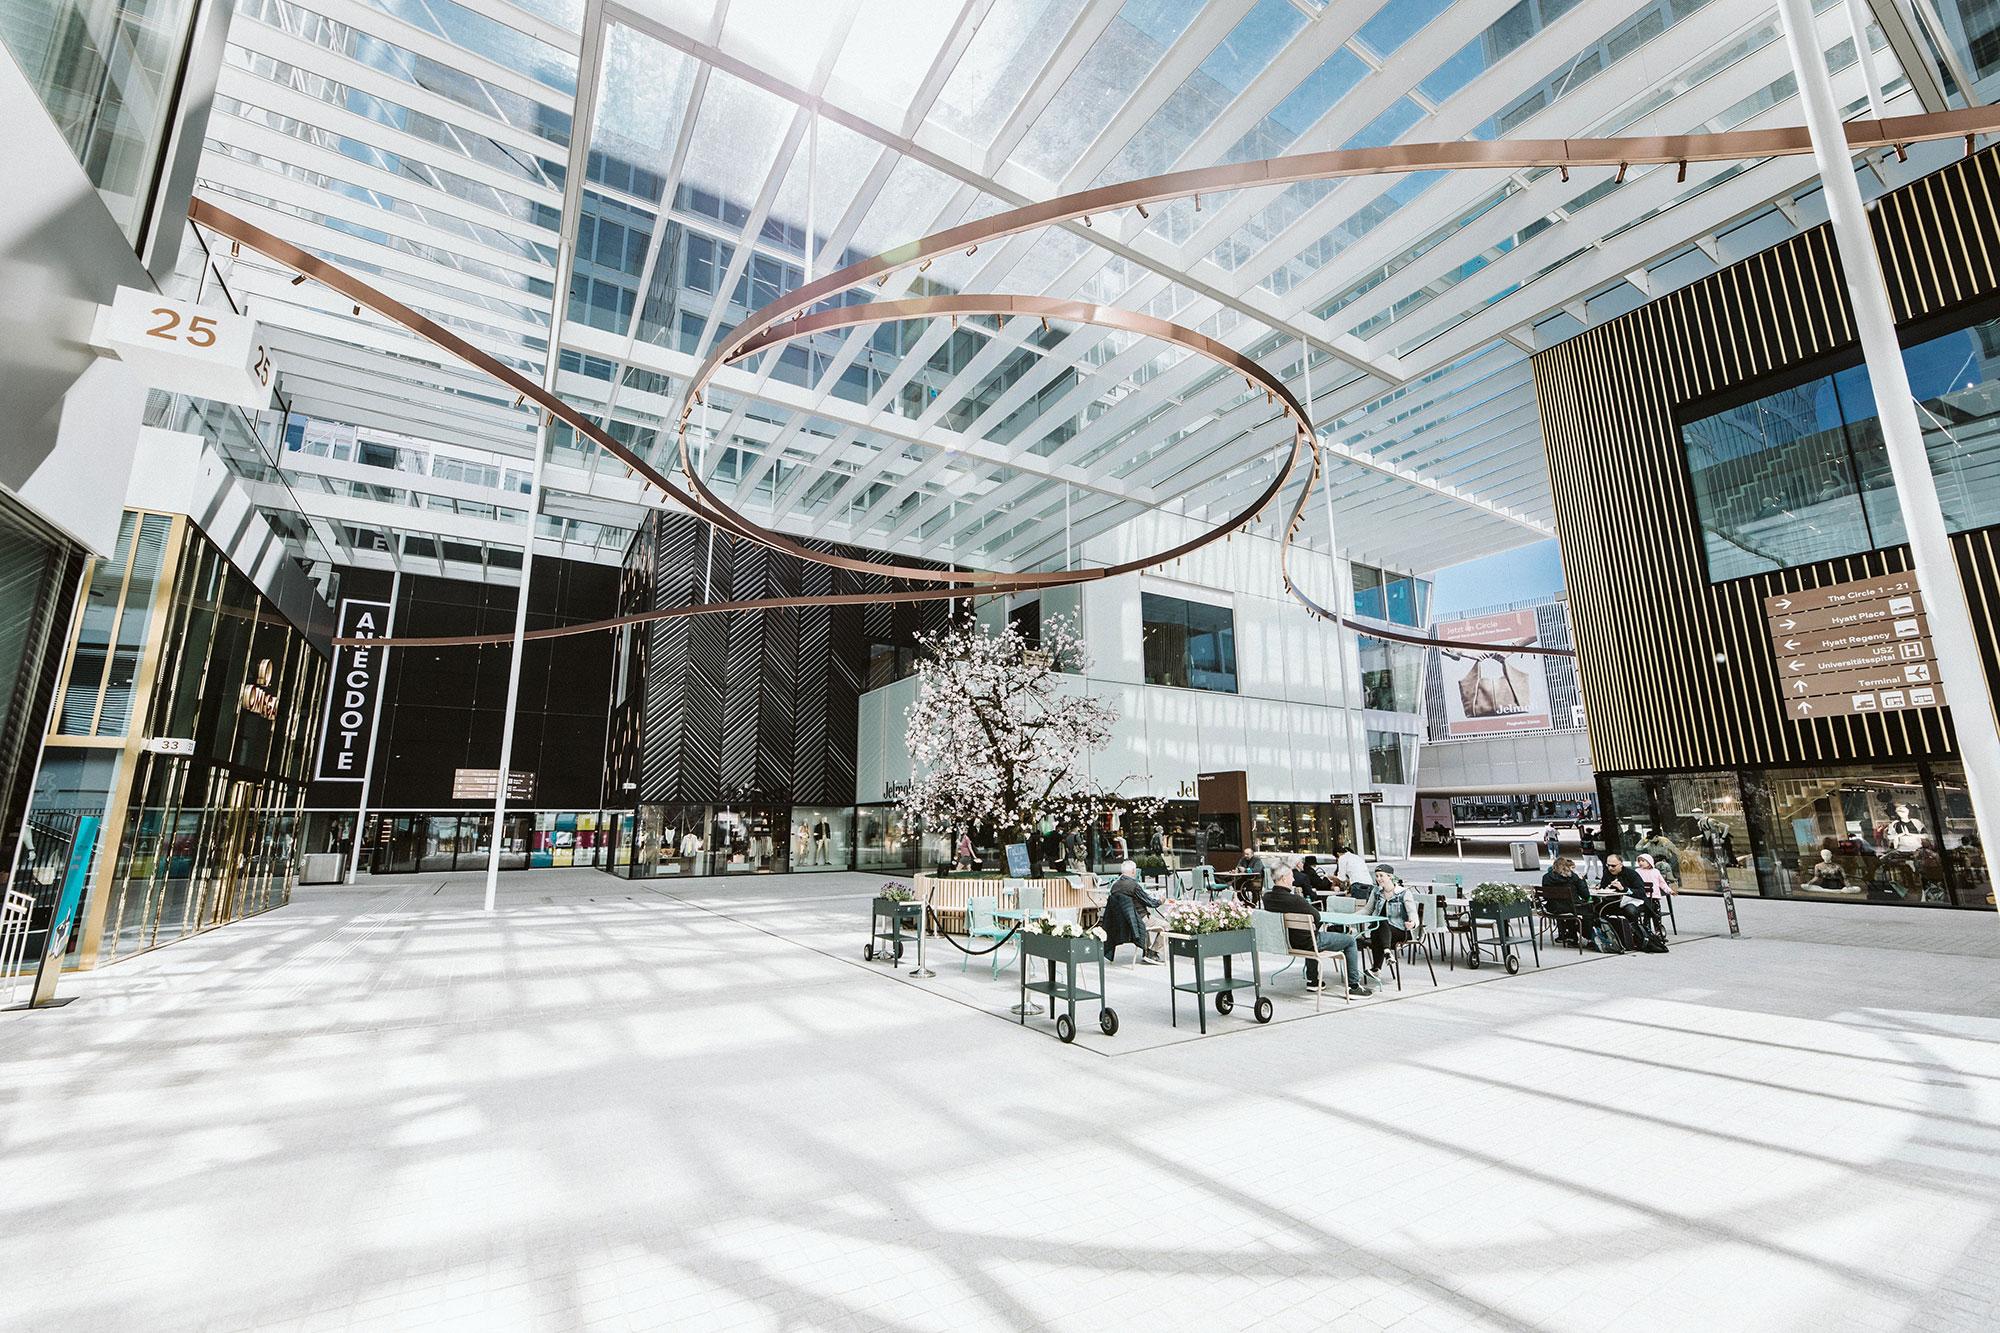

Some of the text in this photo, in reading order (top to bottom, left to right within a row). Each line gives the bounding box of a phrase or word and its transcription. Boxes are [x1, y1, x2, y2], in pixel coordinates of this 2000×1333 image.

[147, 308, 217, 347] 25
[254, 345, 271, 386] 25
[1827, 595, 1845, 603] The
[1847, 589, 1876, 599] Circle
[1896, 582, 1909, 591] 21
[1831, 611, 1886, 624] Hyatt Place
[1822, 633, 1890, 647] Hyatt Regency
[1872, 646, 1894, 655] USZ
[1818, 654, 1896, 670] Universitätsspital
[1858, 676, 1901, 686] Terminal
[337, 612, 375, 770] ANECDOTE
[161, 740, 179, 750] 33
